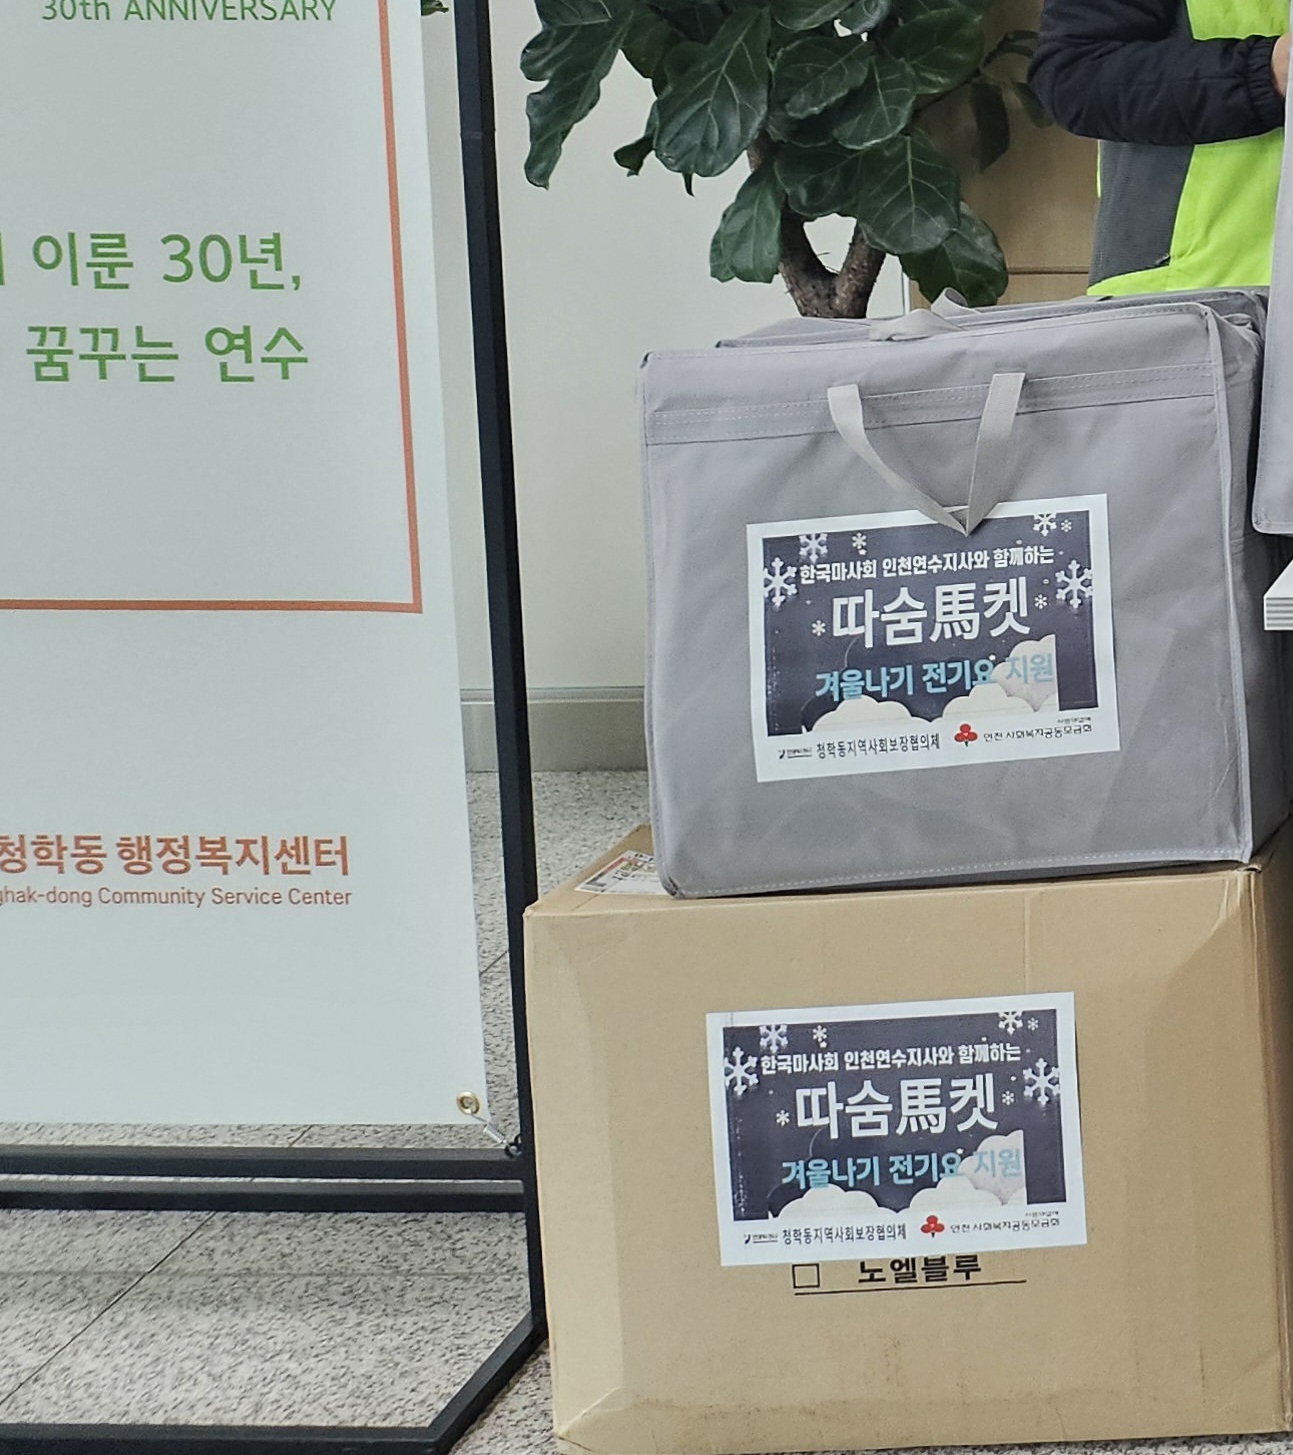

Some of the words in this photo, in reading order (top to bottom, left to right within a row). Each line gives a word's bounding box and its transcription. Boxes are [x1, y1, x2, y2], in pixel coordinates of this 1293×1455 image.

[31, 231, 134, 290] 이룬
[160, 231, 301, 291] 30년,
[26, 325, 180, 383] 꿈꾸는
[204, 324, 309, 383] 연수
[800, 558, 877, 585] 한국마사회
[882, 550, 990, 577] 인천연수지사와
[993, 545, 1055, 569] 함께하는
[832, 576, 1031, 648] 따숨馬켓
[814, 664, 914, 702] 겨울나기
[922, 658, 996, 694] 전기요
[1004, 653, 1053, 685] 지원
[0, 835, 108, 875] 청학동
[116, 834, 350, 877] 행정복지센터
[98, 886, 206, 909] Community
[211, 888, 282, 906] Service
[287, 888, 352, 906] Center
[761, 1051, 839, 1075] 한국마사회
[844, 1045, 955, 1071] 인천연수지사와
[958, 1042, 1021, 1065] 함께하는
[795, 1072, 999, 1140] 따숨馬켓
[781, 1155, 880, 1189] 겨울나기
[888, 1150, 964, 1185] 전기요
[972, 1147, 1022, 1179] 지원
[858, 1254, 983, 1285] 노엘블루
